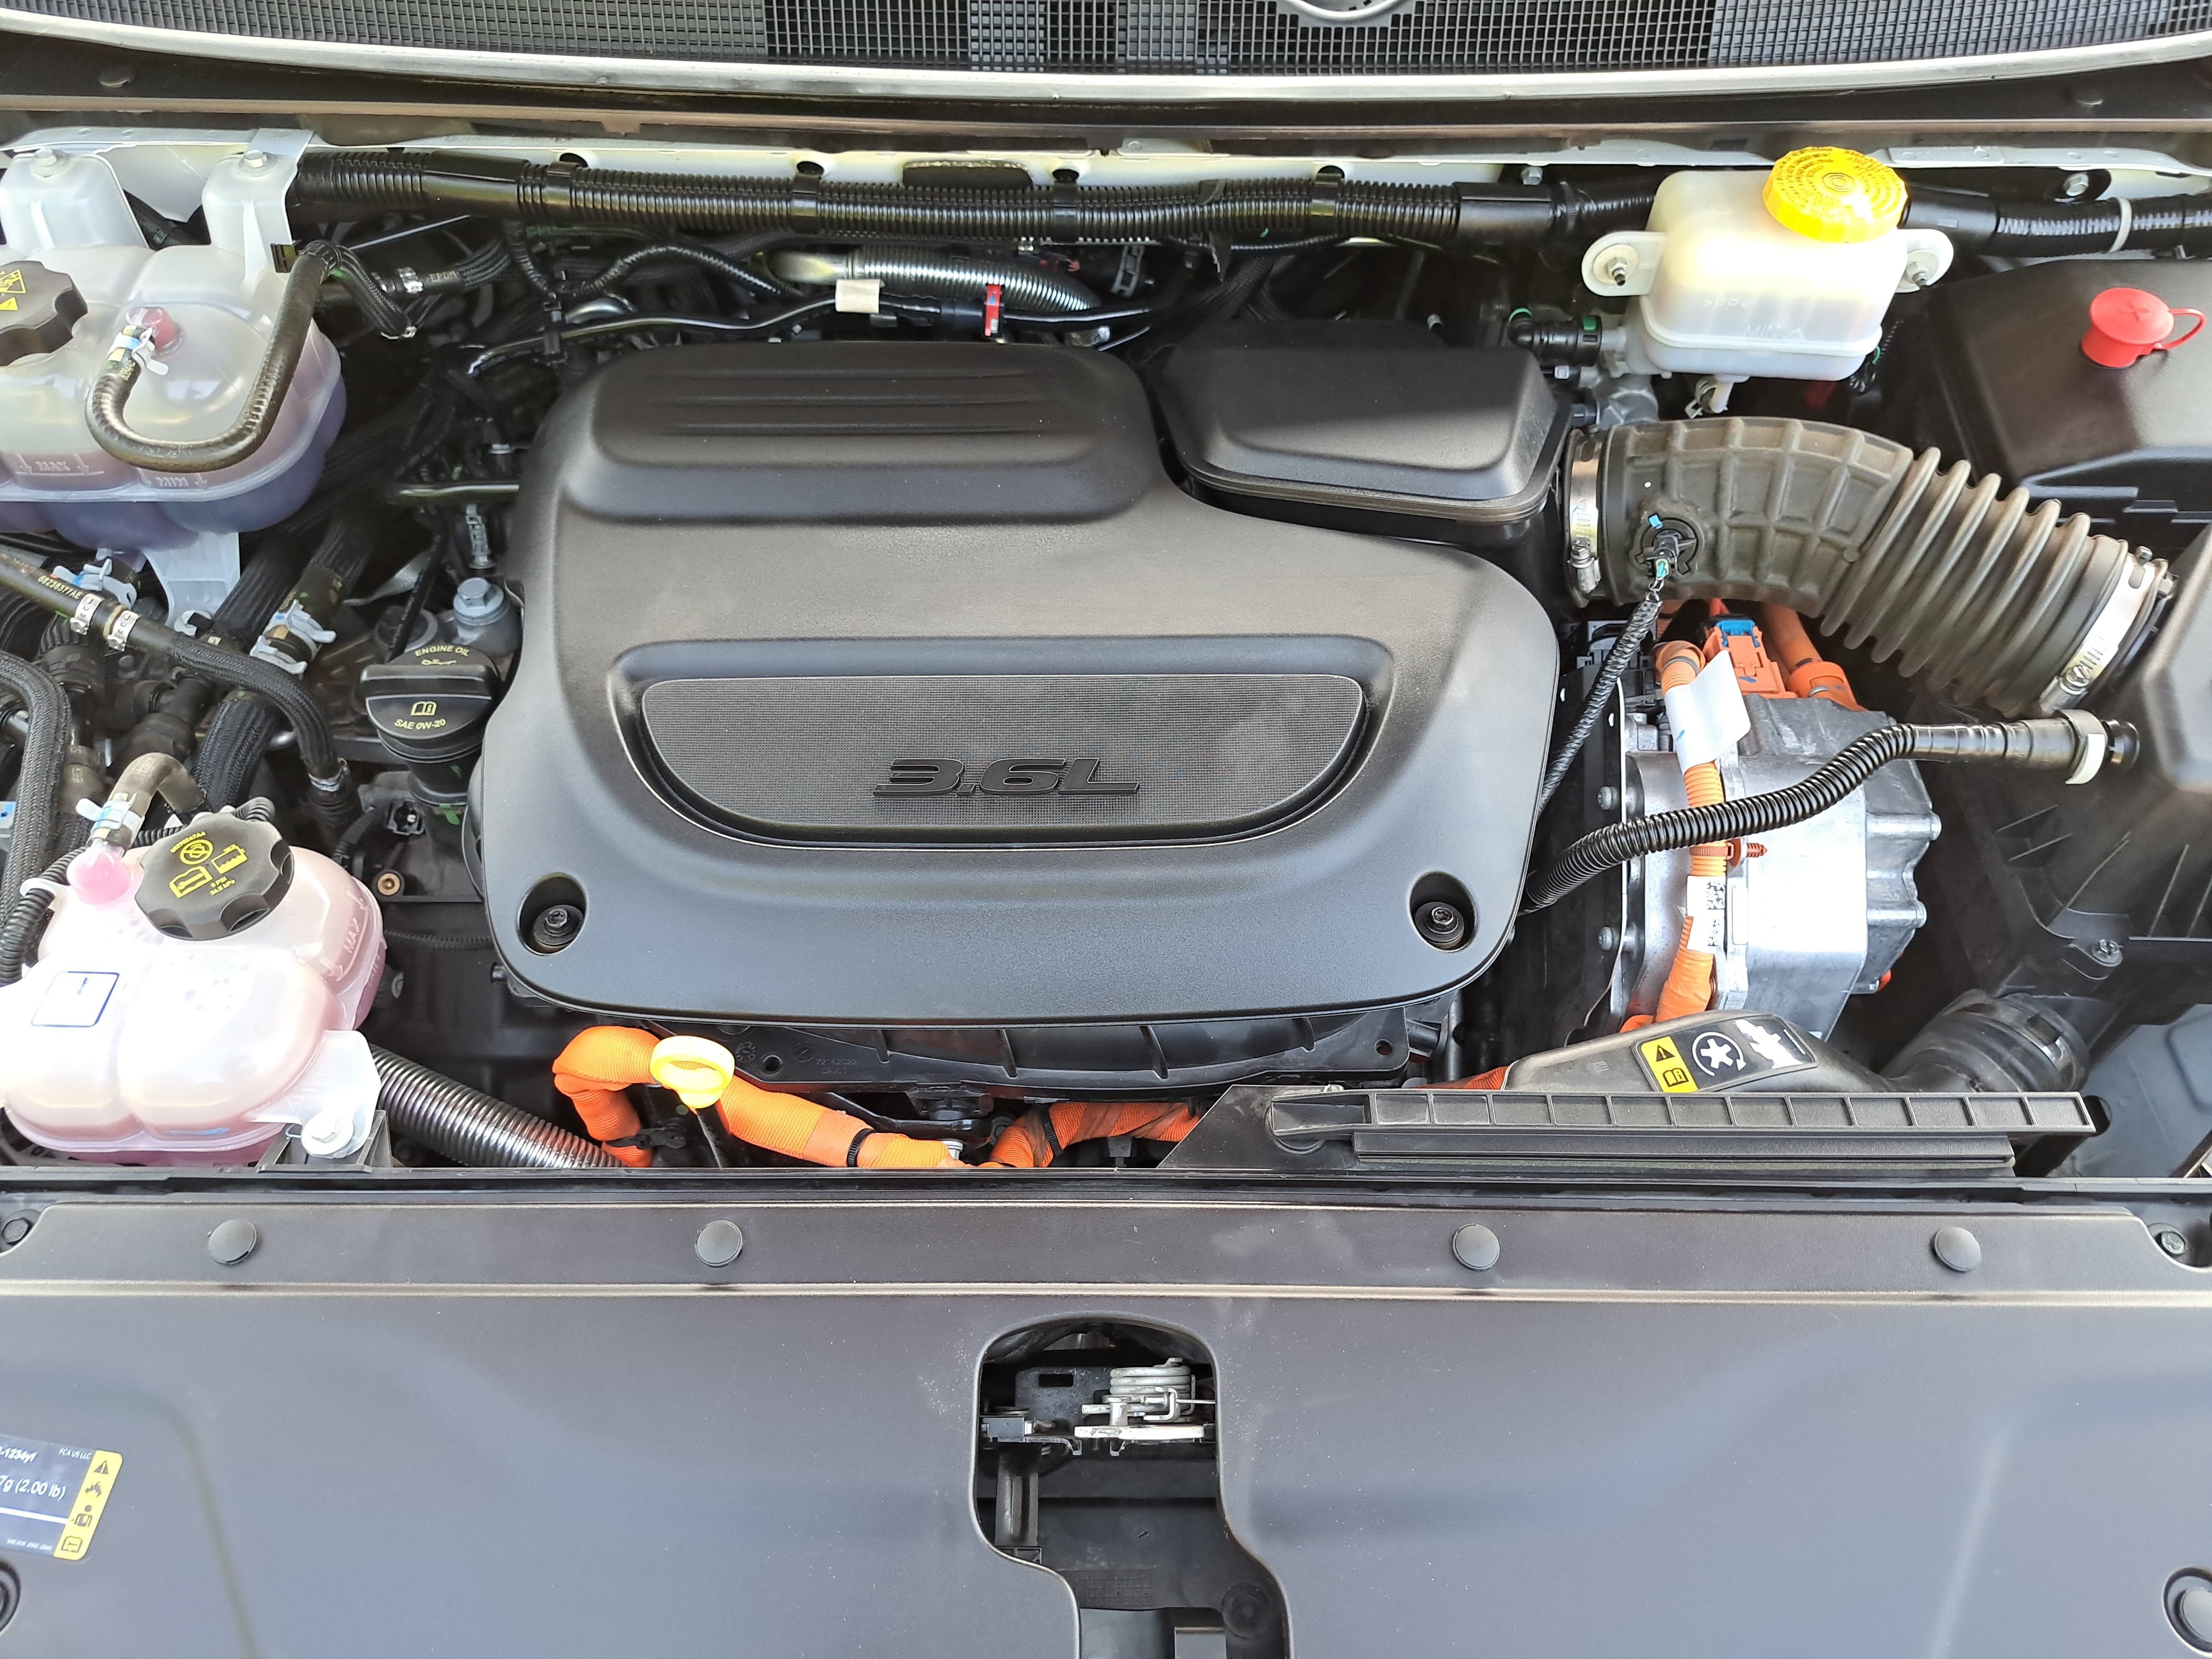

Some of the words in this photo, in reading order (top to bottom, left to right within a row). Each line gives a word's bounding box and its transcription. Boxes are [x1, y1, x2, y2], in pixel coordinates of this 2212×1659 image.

[414, 645, 454, 657] ENGINE
[455, 647, 470, 657] OIL
[394, 719, 415, 730] SAE
[415, 719, 447, 730] 0W-20
[873, 758, 1140, 796] 3.6L
[15, 1478, 48, 1495] (2.00
[48, 1482, 66, 1501] lb)
